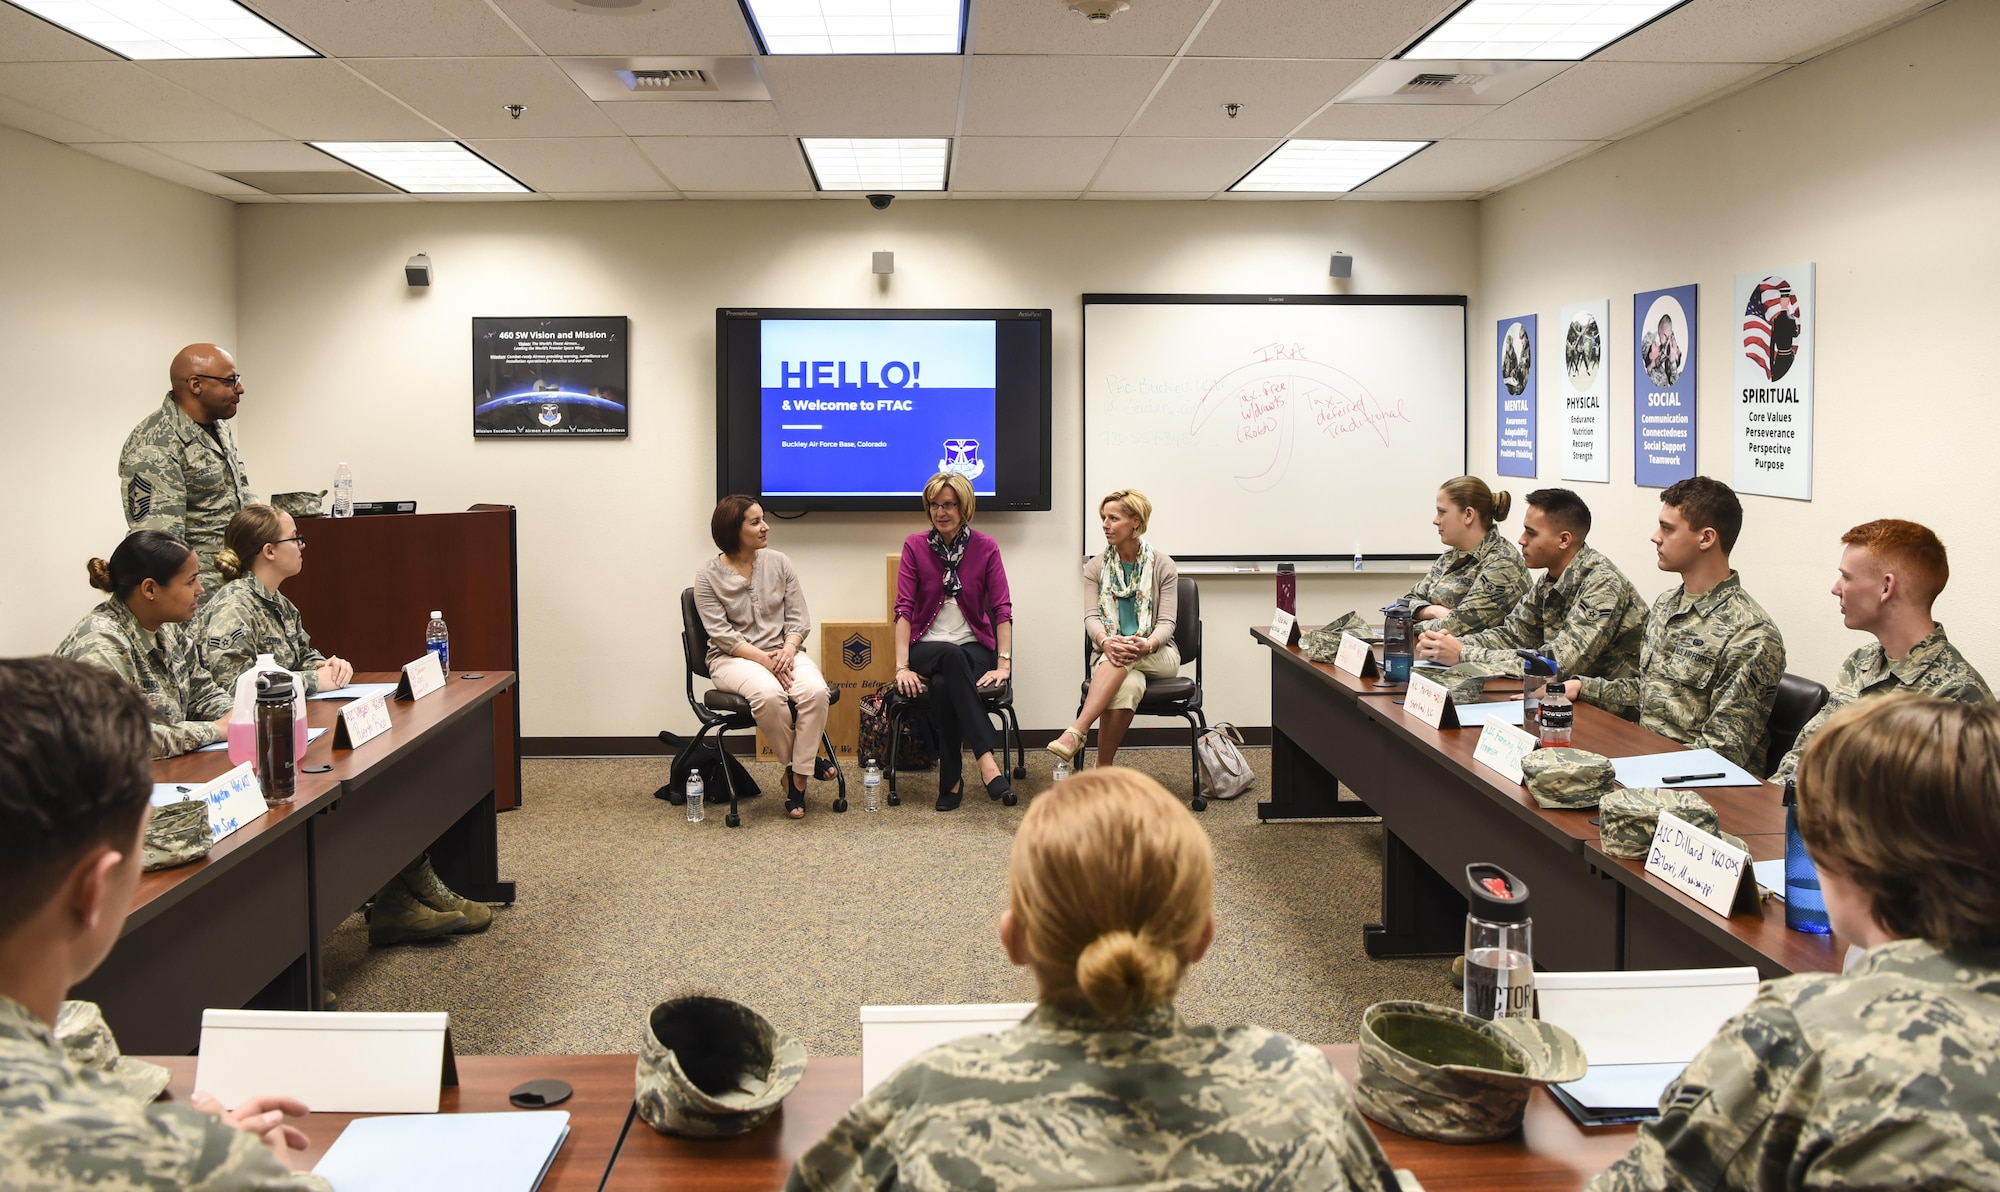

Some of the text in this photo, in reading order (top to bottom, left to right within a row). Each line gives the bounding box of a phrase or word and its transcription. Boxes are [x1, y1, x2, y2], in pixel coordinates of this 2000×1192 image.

[499, 331, 607, 339] 460 SW Vision and Mission
[1253, 342, 1307, 363] IRA
[781, 361, 920, 389] HELLO!
[1648, 392, 1681, 407] SOCIAL
[1742, 388, 1800, 404] SPIRITUAL
[782, 399, 913, 411] & Welcome to FTAC
[1504, 400, 1528, 411] MENTAL
[1566, 396, 1600, 409] PHYSICAL
[1505, 417, 1527, 425] Awareness
[1571, 415, 1595, 423] Endurance
[1641, 413, 1689, 424] Communication
[1748, 411, 1792, 422] Core Values
[1504, 427, 1528, 438] Adaptability
[1572, 427, 1593, 436] Nutrition
[1642, 427, 1687, 438] Connectedness
[1745, 427, 1795, 438] Perseverance
[1501, 438, 1532, 449] Decision Making
[1572, 440, 1593, 450] Recovery
[1643, 440, 1686, 454] Social Support
[1500, 449, 1533, 461] Positive Thinking
[1573, 451, 1593, 462] Strength
[1649, 454, 1681, 465] Teamwork
[1755, 458, 1784, 471] Purpose
[1692, 652, 1713, 668] FORCE
[1674, 829, 1705, 861] Dillard
[1678, 865, 1716, 897] Mississippi
